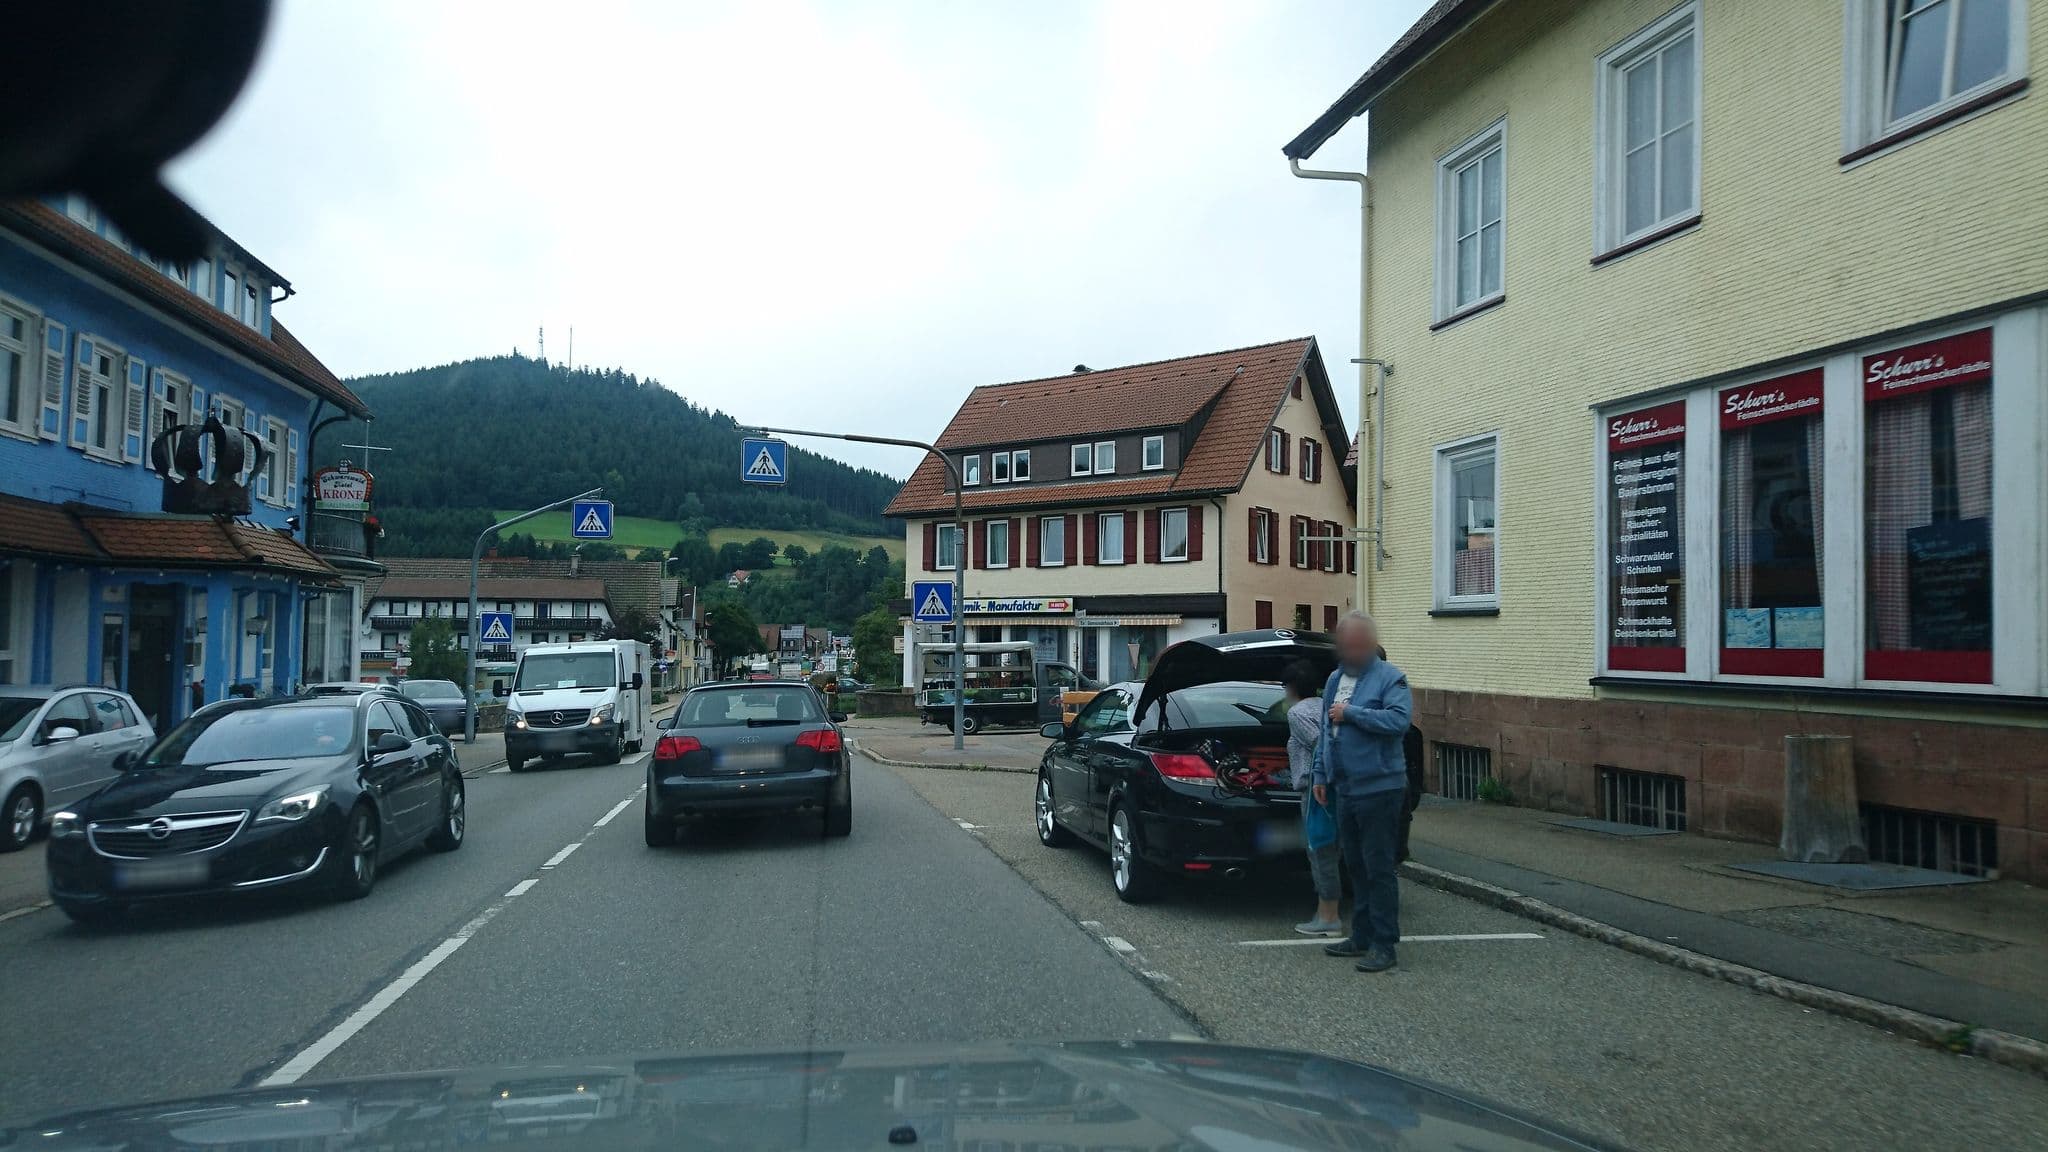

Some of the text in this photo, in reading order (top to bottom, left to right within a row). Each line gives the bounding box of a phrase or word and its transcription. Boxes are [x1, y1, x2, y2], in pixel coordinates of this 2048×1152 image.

[1613, 451, 1681, 471] Feines aus der
[1614, 466, 1679, 485] Genussregion
[323, 489, 363, 500] KRONE
[1618, 482, 1675, 498] Baiersbronn
[1622, 506, 1667, 518] Hauseigene
[1626, 517, 1662, 530] Räucher-
[1620, 529, 1669, 543] spezialitäten
[1615, 551, 1674, 564] Schwarzwälder
[1626, 564, 1662, 575] Schinken
[1620, 584, 1669, 595] Hausmacher
[1621, 596, 1668, 606] Dosenwurst
[1618, 616, 1672, 627] Schmackhafte
[1615, 628, 1677, 639] Geschenkartikel
